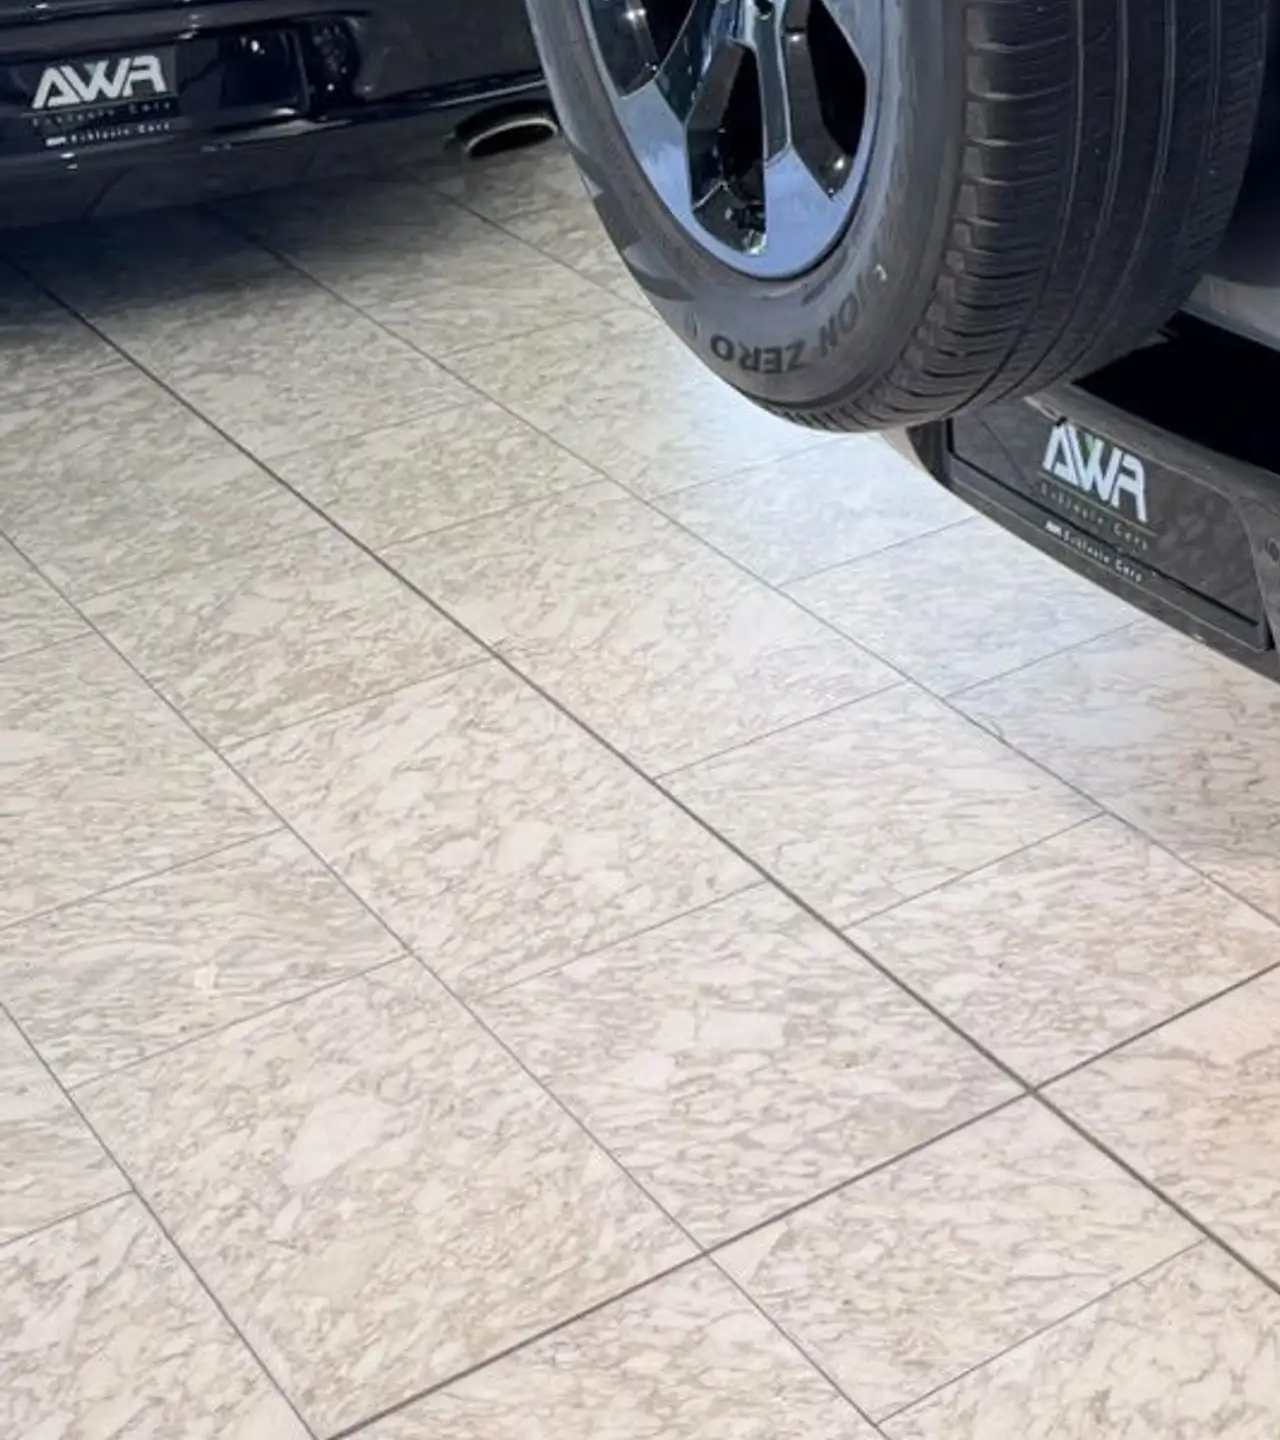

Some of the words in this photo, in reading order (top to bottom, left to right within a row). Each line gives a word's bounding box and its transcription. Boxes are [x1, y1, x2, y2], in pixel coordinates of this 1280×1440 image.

[31, 54, 168, 110] AWA
[710, 333, 806, 374] ZERO
[1041, 421, 1148, 523] AWA
